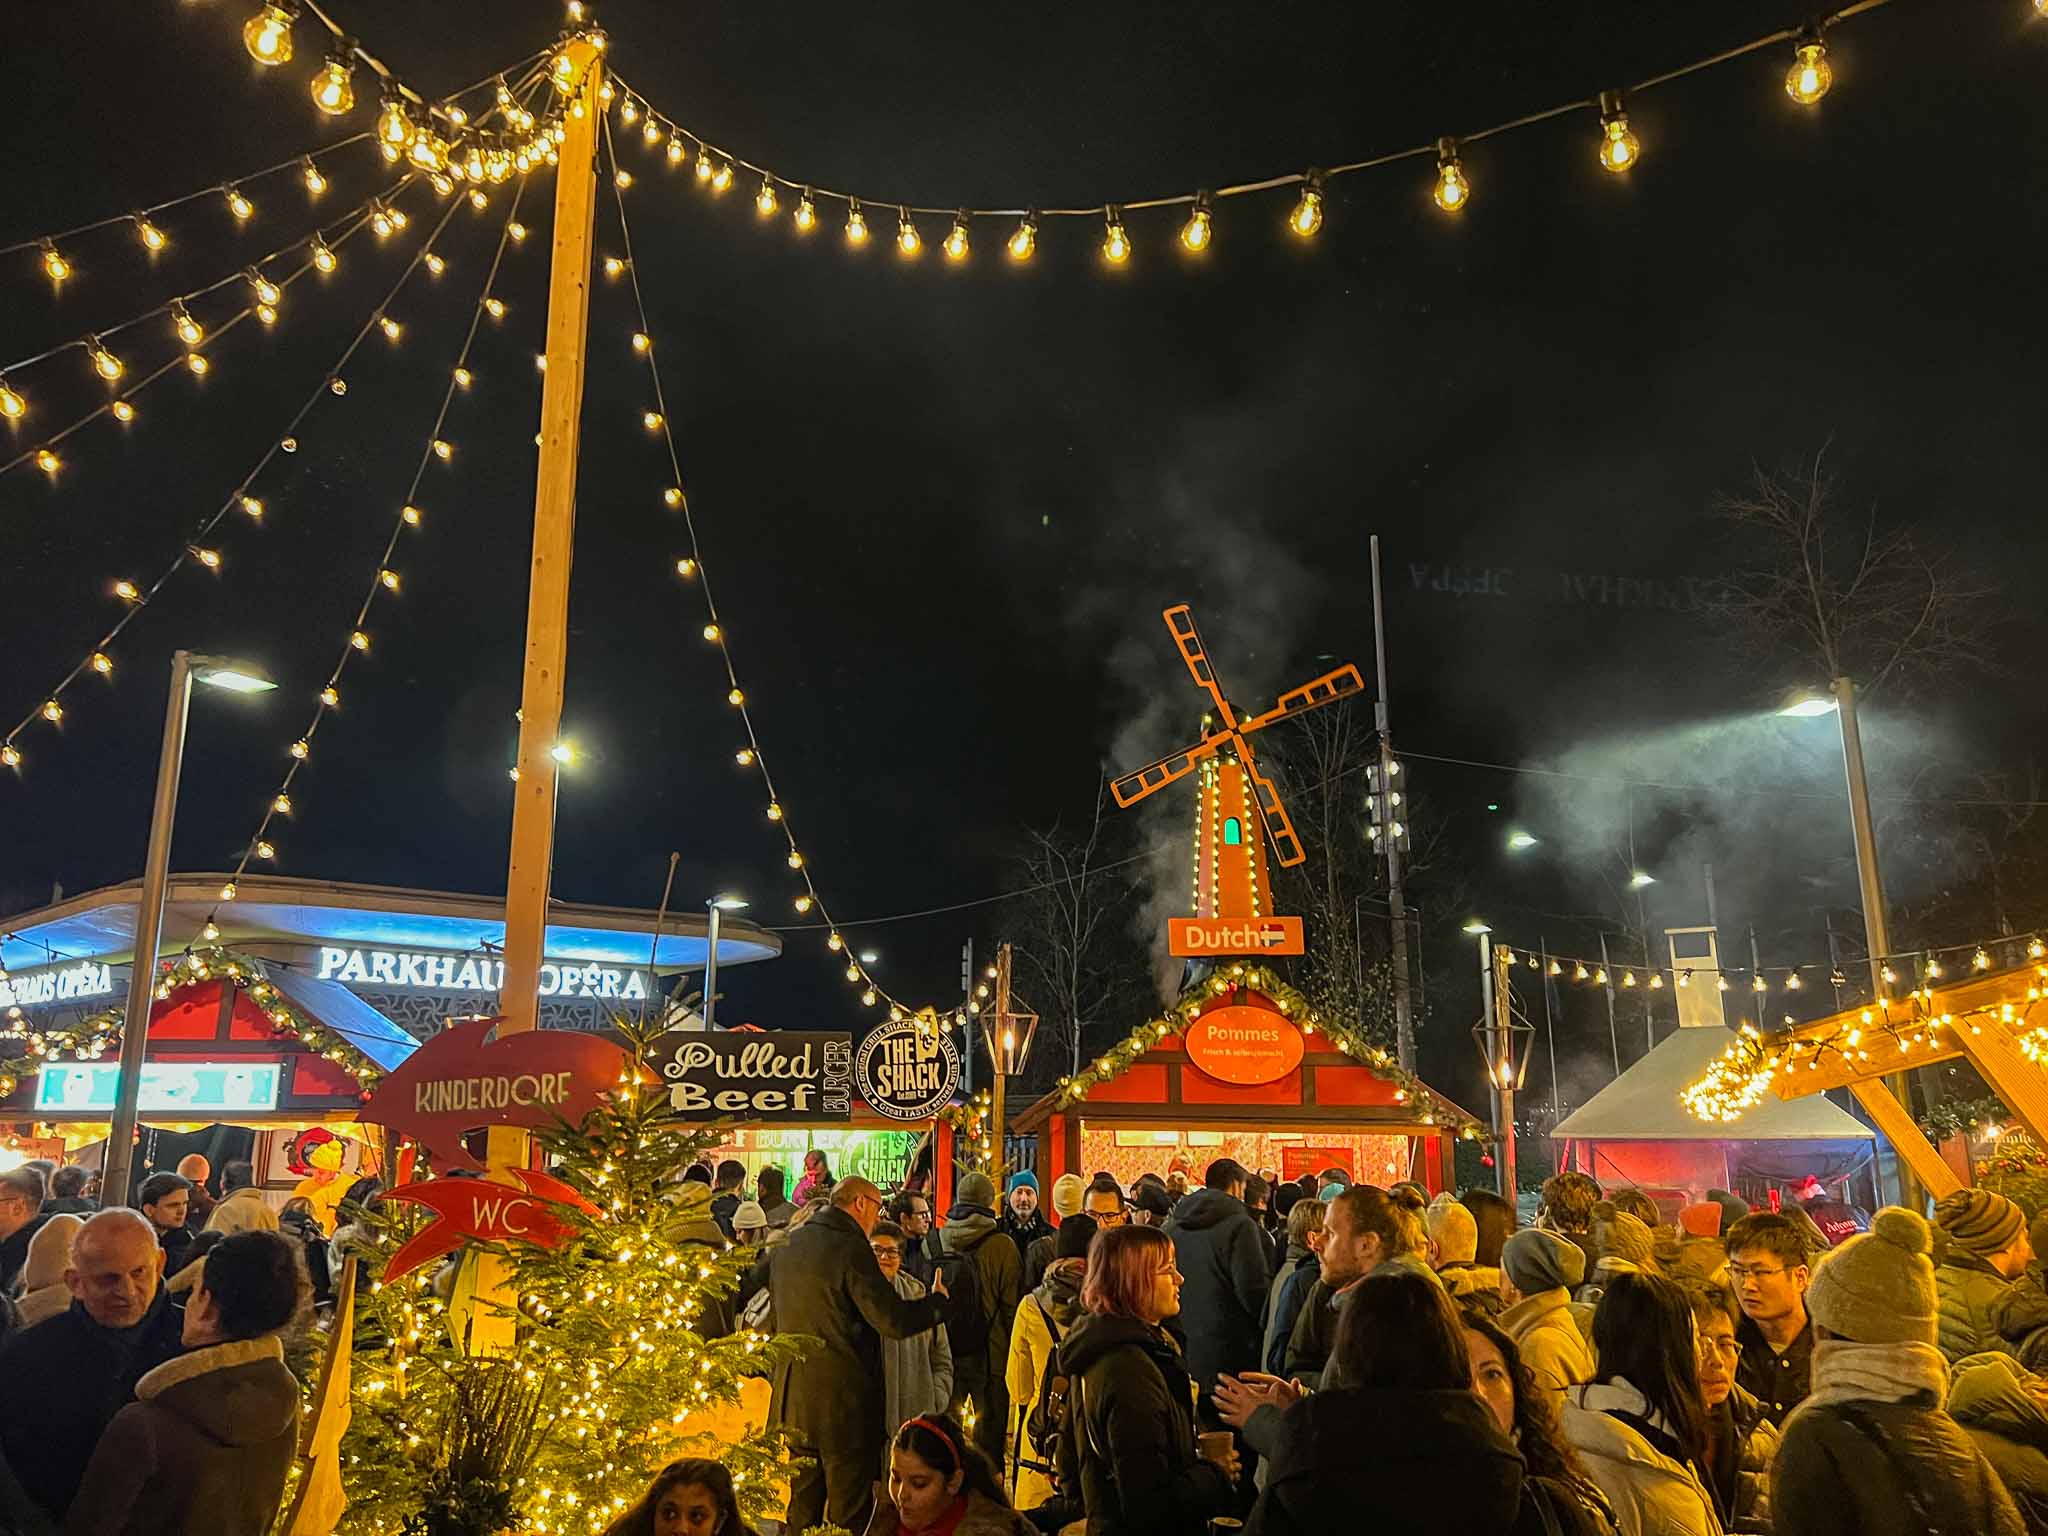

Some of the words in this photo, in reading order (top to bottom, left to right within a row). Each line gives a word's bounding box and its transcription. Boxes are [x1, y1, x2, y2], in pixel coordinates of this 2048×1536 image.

[317, 945, 505, 991] PARKHAU
[1207, 1025, 1280, 1042] Pommes
[664, 1042, 819, 1079] Pulled
[881, 1038, 915, 1065] THE
[940, 1037, 958, 1062] STYLE
[823, 1041, 852, 1113] BURGER
[877, 1062, 941, 1098] SHACK
[949, 1062, 959, 1083] with
[415, 1072, 572, 1113] KINDERDORF
[667, 1082, 817, 1111] Beef
[931, 1083, 954, 1109] served
[879, 1102, 903, 1117] Great
[904, 1101, 933, 1118] TASTE
[863, 1134, 888, 1160] THE
[857, 1158, 906, 1183] SHACK
[473, 1197, 533, 1234] WC
